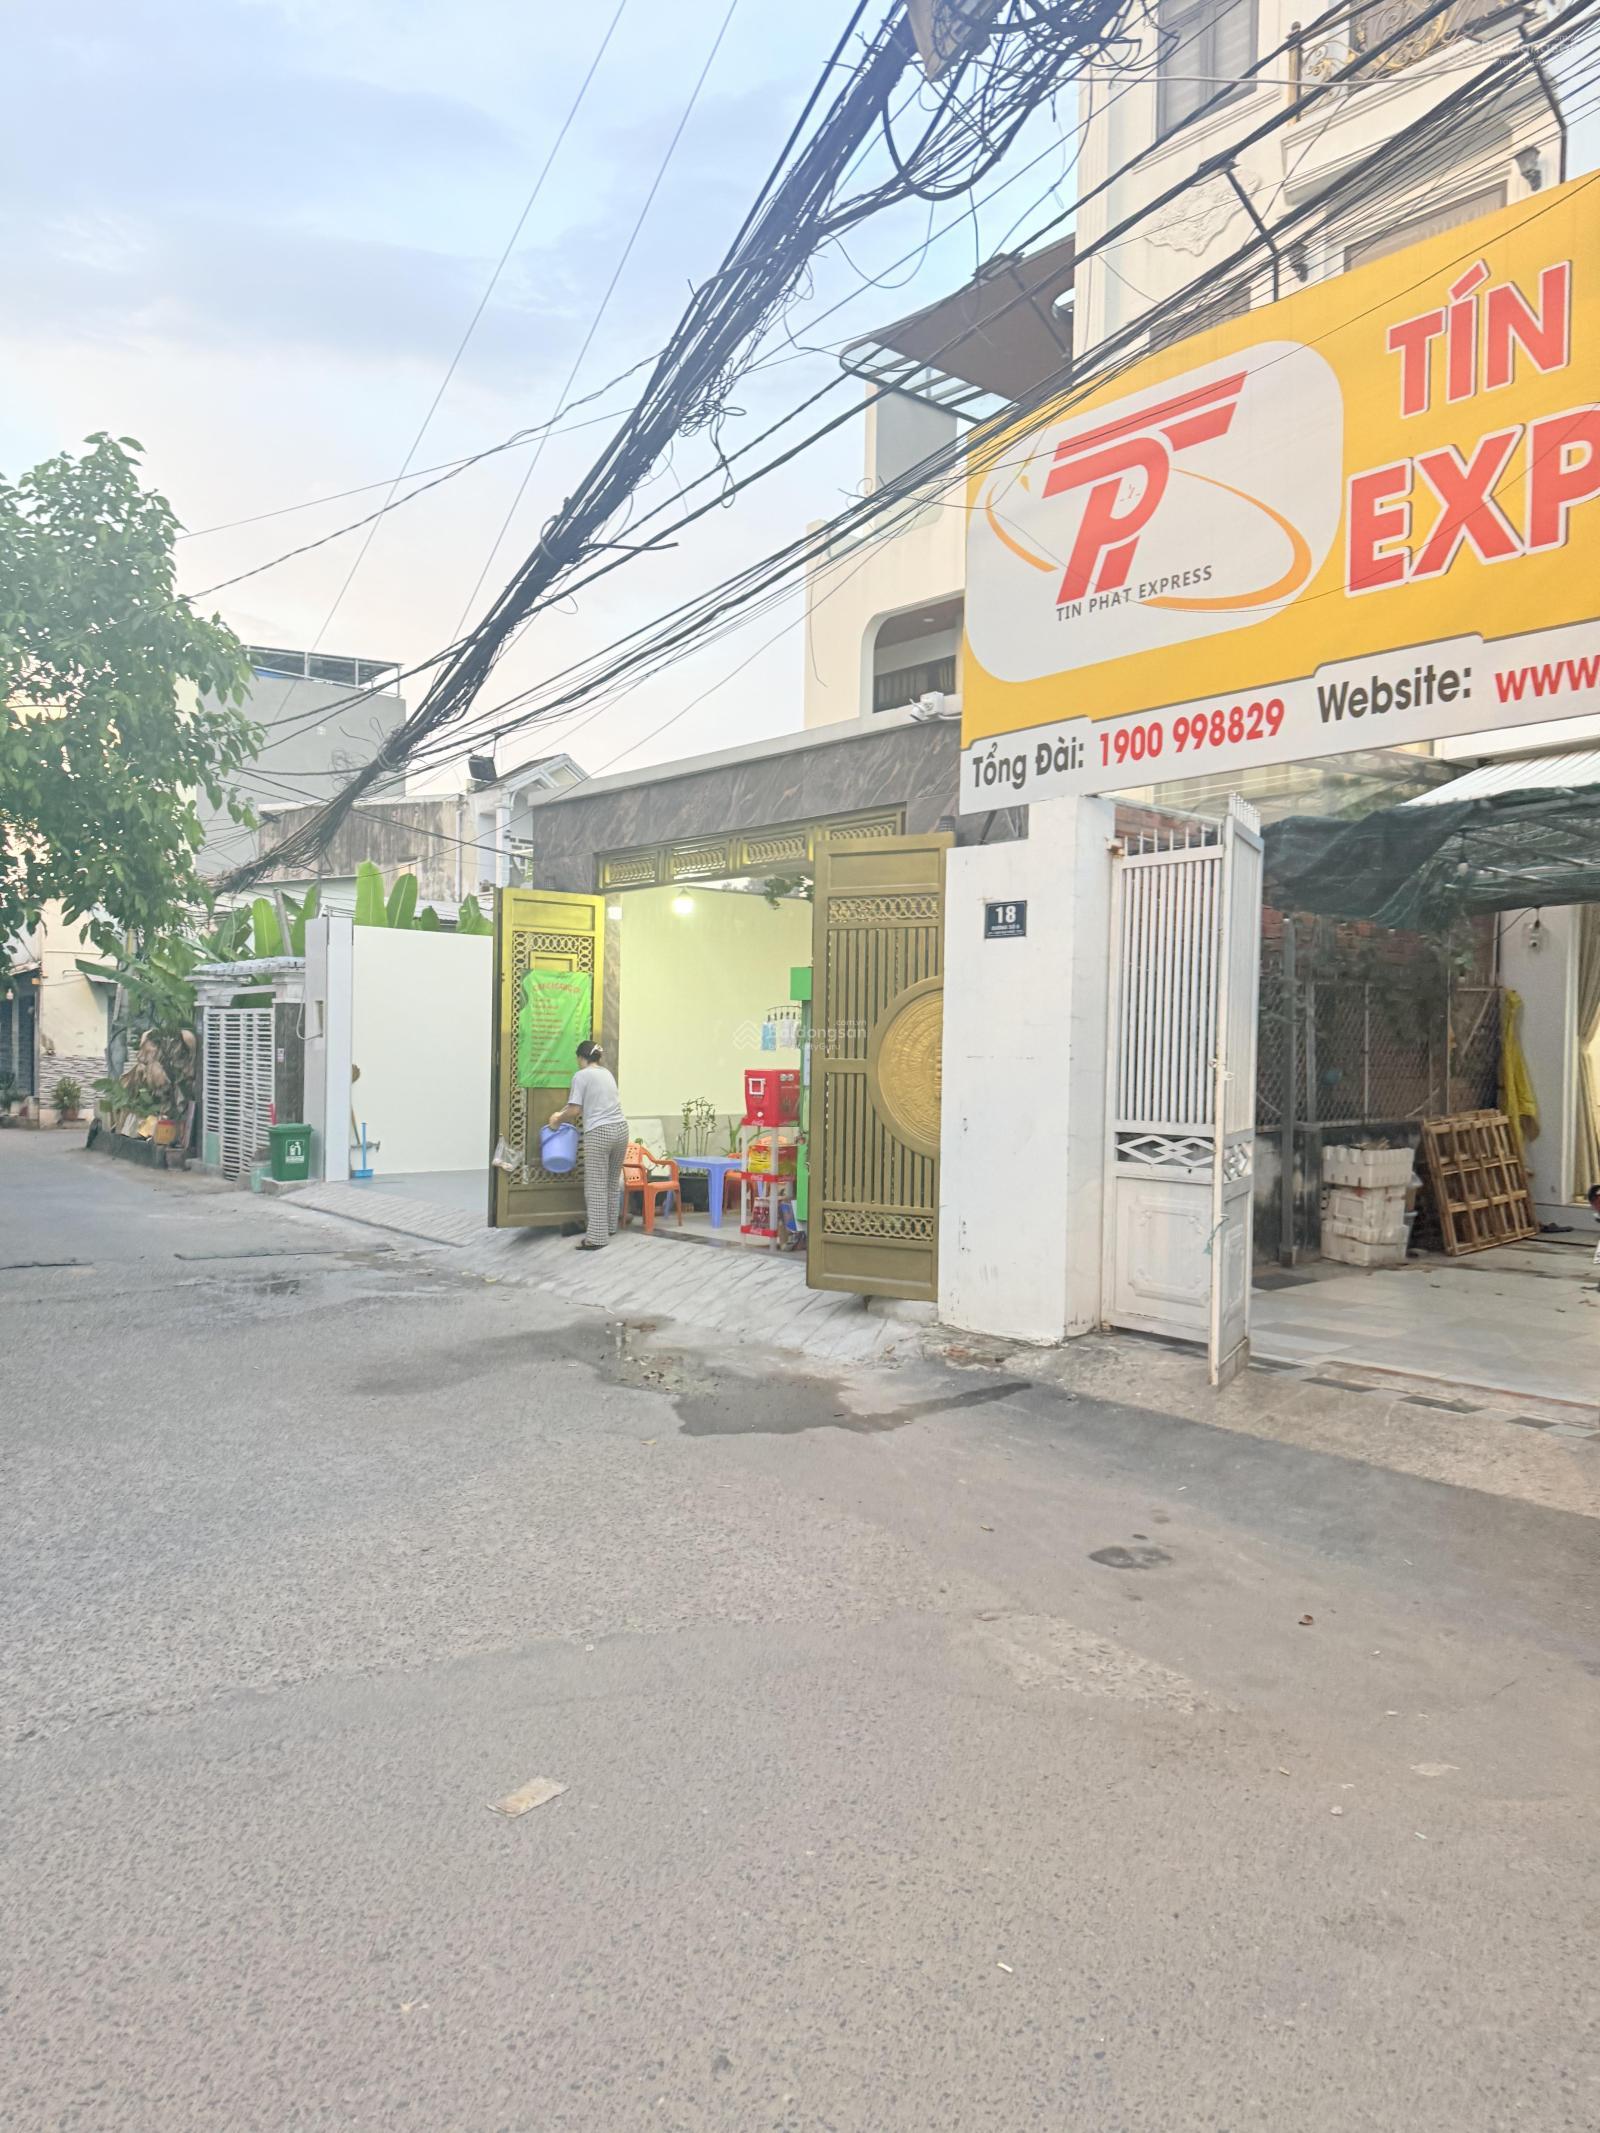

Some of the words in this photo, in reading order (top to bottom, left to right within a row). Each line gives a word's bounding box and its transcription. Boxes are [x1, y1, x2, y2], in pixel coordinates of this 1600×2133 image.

[1387, 259, 1571, 418] TÍN
[1345, 402, 1600, 598] EXP
[1056, 602, 1082, 622] TIN
[1088, 588, 1132, 612] PHAT
[1138, 565, 1213, 599] EXPRESS
[1317, 665, 1472, 723] Website:
[972, 742, 1027, 790] Tổng
[1035, 736, 1084, 776] Đài:
[1100, 722, 1163, 767] 1900
[1173, 698, 1285, 753] 998829
[995, 905, 1016, 924] 18
